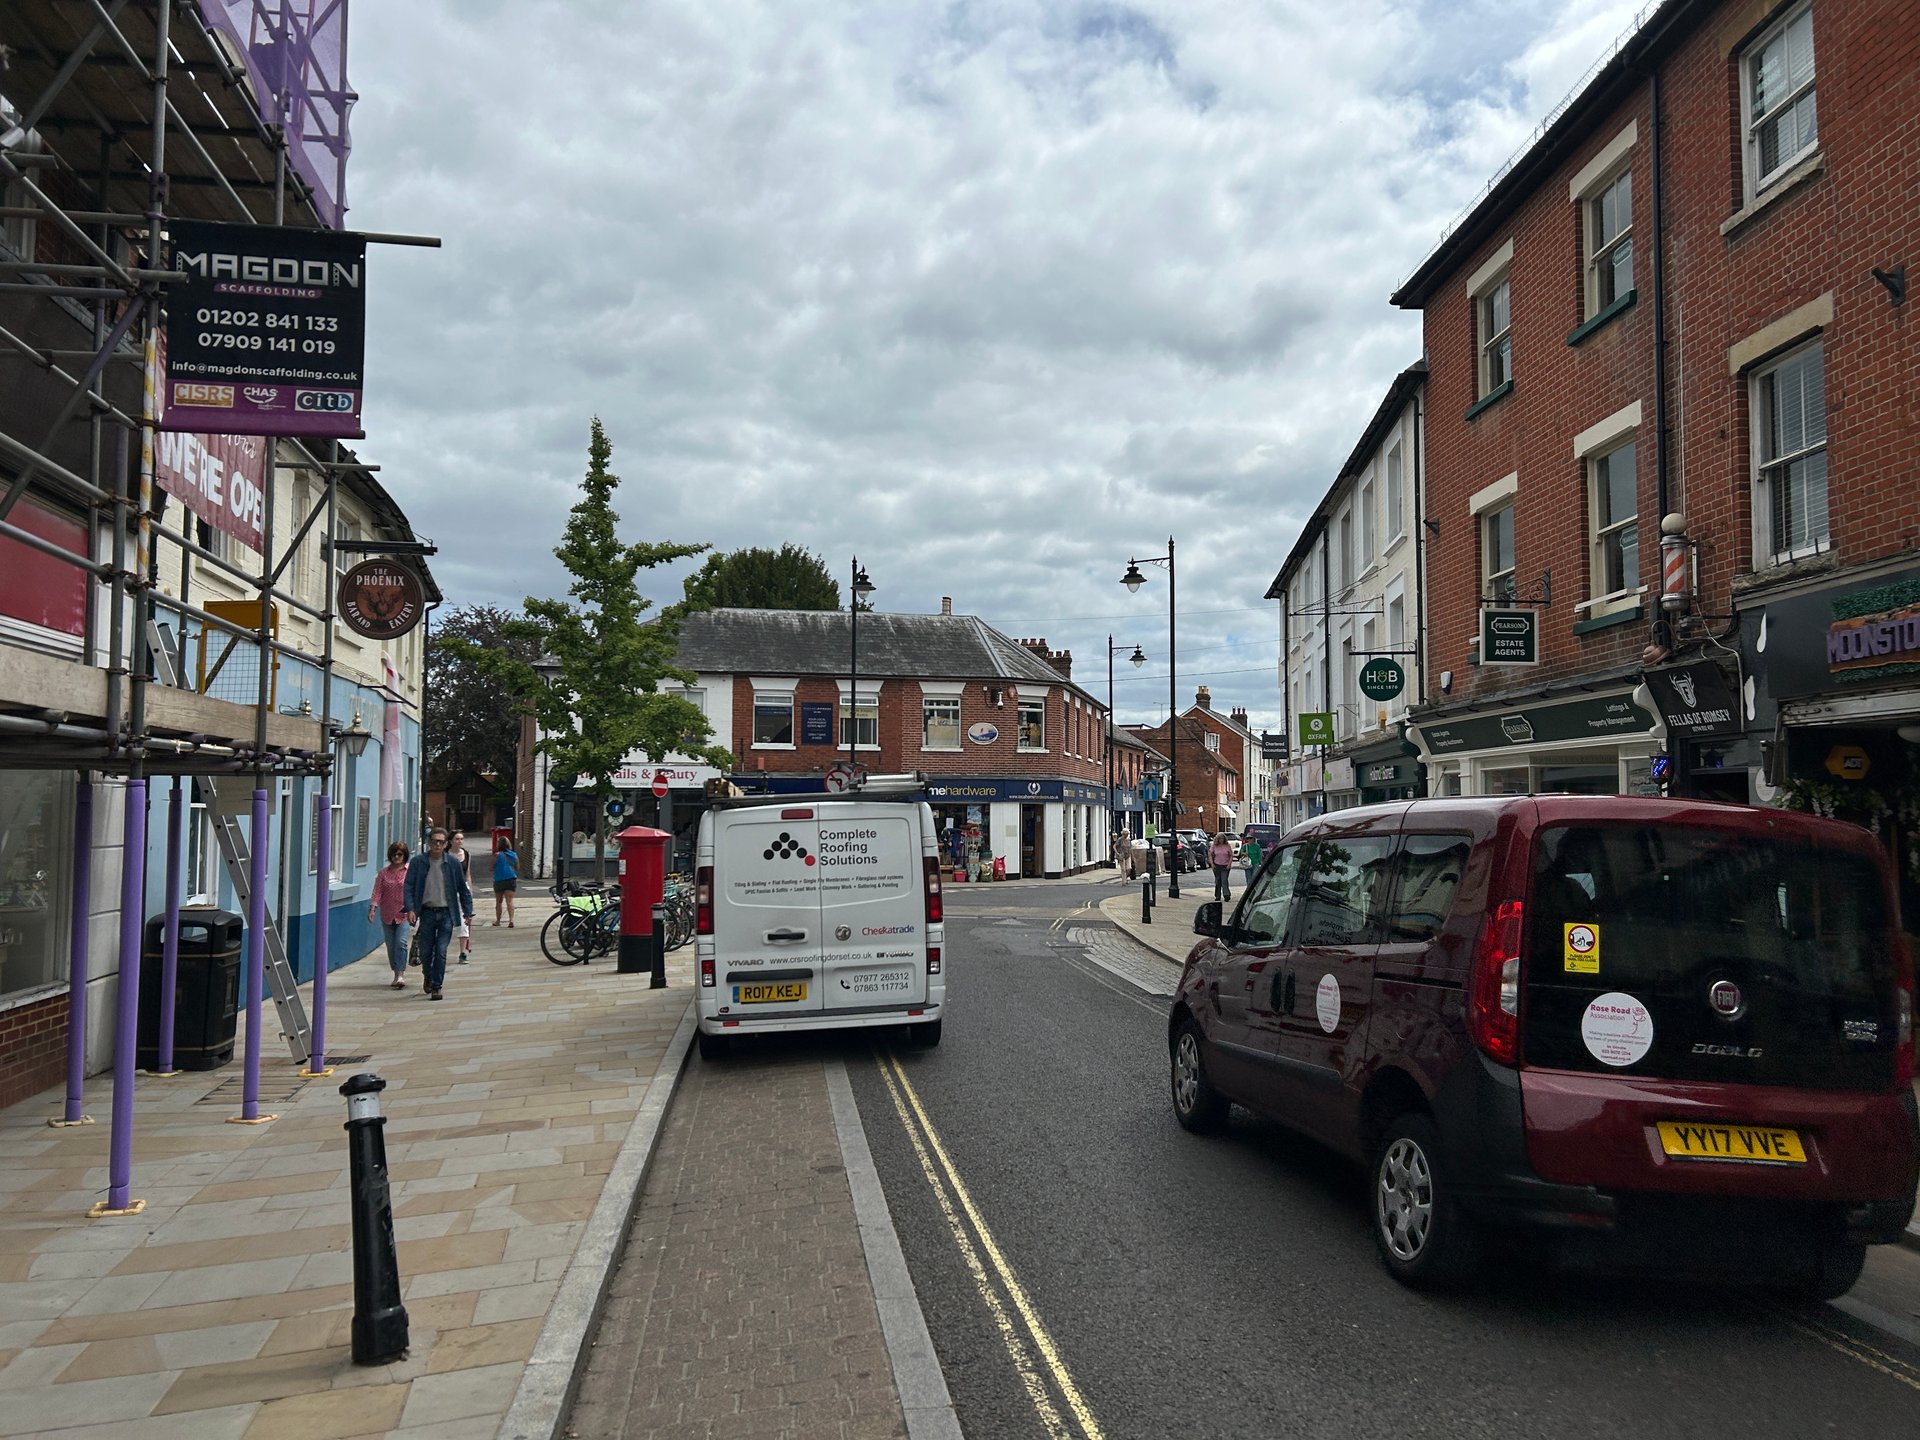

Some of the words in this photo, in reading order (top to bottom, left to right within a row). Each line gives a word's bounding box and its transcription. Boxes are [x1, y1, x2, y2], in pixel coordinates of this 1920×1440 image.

[176, 251, 358, 288] MAGDON
[220, 283, 316, 297] SCAFFOLDING
[197, 308, 259, 327] 01202
[265, 313, 299, 330] 841
[305, 315, 338, 332] 133
[198, 332, 262, 350] 07909
[267, 337, 296, 352] 141
[302, 339, 335, 354] 019
[172, 361, 357, 381] info@magdonscaffolding.co.uk
[175, 384, 233, 401] CISRS
[243, 386, 277, 397] CHAS
[160, 431, 223, 507] WE'RE
[231, 471, 265, 533] OPE
[373, 568, 387, 576] THE
[356, 575, 404, 587] PHOENIX
[388, 602, 414, 629] EATERY
[1495, 622, 1526, 630] PEARSONS
[1496, 639, 1524, 648] ESTATE
[1827, 617, 1920, 664] MOONSTO
[1495, 648, 1526, 657] AGENTS
[1366, 670, 1398, 683] H&B
[1605, 704, 1625, 712] Lettings
[1605, 715, 1636, 726] Management
[1668, 713, 1694, 726] FELLAS
[1692, 712, 1702, 724] OF
[1700, 709, 1731, 723] ROMSEY
[1843, 757, 1862, 769] ADT
[641, 769, 651, 779] &
[929, 785, 997, 797] mehardware
[819, 829, 877, 842] Complete
[819, 842, 868, 855] Roofing
[819, 853, 878, 866] Solutions
[886, 873, 904, 881] systems
[861, 924, 915, 936] Checkatrade
[727, 959, 764, 967] VIVARO
[769, 952, 872, 966] www.crsroofingdorset.co.uk
[854, 973, 878, 983] 07977
[880, 972, 909, 981] 265312
[744, 985, 773, 998] RO17
[776, 984, 802, 998] KEJ
[854, 983, 879, 993] 07863
[881, 981, 909, 991] 117734
[1717, 990, 1735, 1006] FIAT
[1590, 1004, 1609, 1012] Rose
[1610, 1006, 1631, 1015] Road
[1590, 1012, 1626, 1021] Association
[1674, 1126, 1731, 1152] YY17
[1737, 1129, 1791, 1157] VVE
